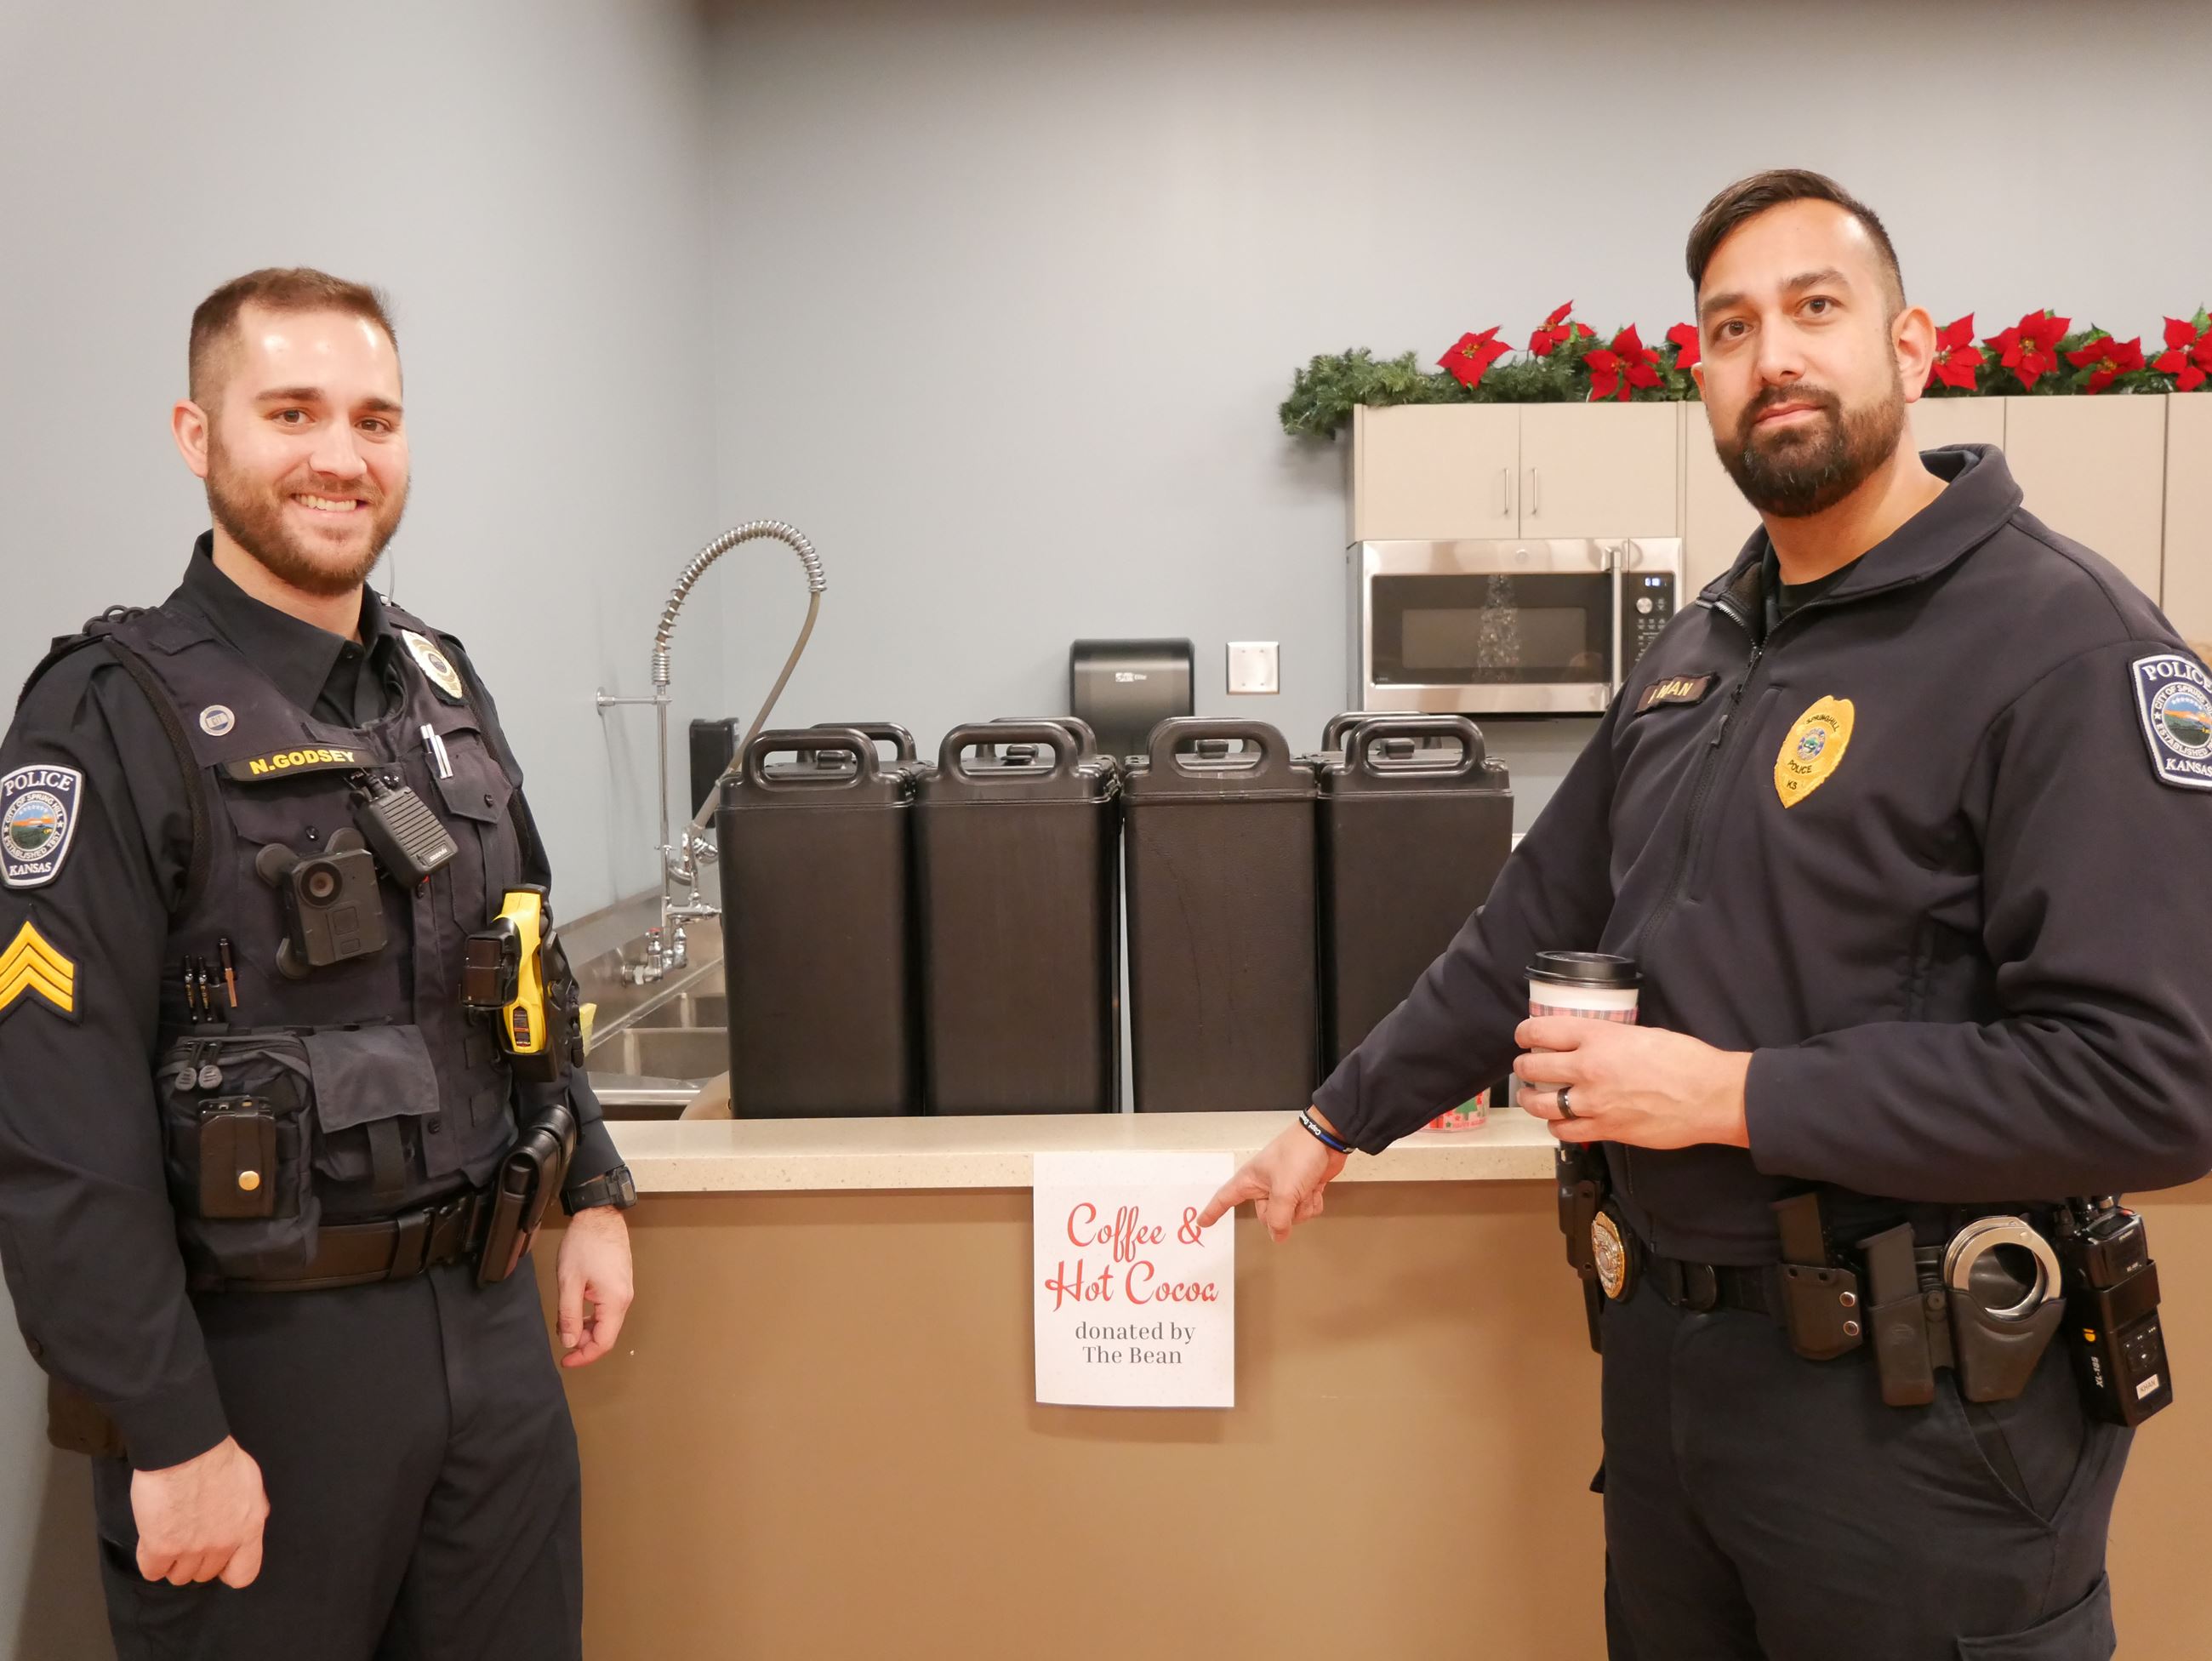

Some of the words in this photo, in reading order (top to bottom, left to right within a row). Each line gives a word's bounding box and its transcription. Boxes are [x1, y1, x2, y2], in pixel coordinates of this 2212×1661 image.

[248, 749, 355, 774] N.GODSEY
[1787, 759, 1812, 774] POLICE
[3, 770, 73, 796] POLICE
[9, 862, 52, 876] KANSAS
[1067, 1202, 1166, 1263] Coffee
[1177, 1207, 1205, 1247] &
[1045, 1259, 1115, 1312] Hot
[1125, 1260, 1219, 1304] Cocoa
[1075, 1321, 1163, 1340] donated
[1171, 1321, 1196, 1344] by
[1082, 1345, 1123, 1364] The
[1129, 1346, 1182, 1364] Bean
